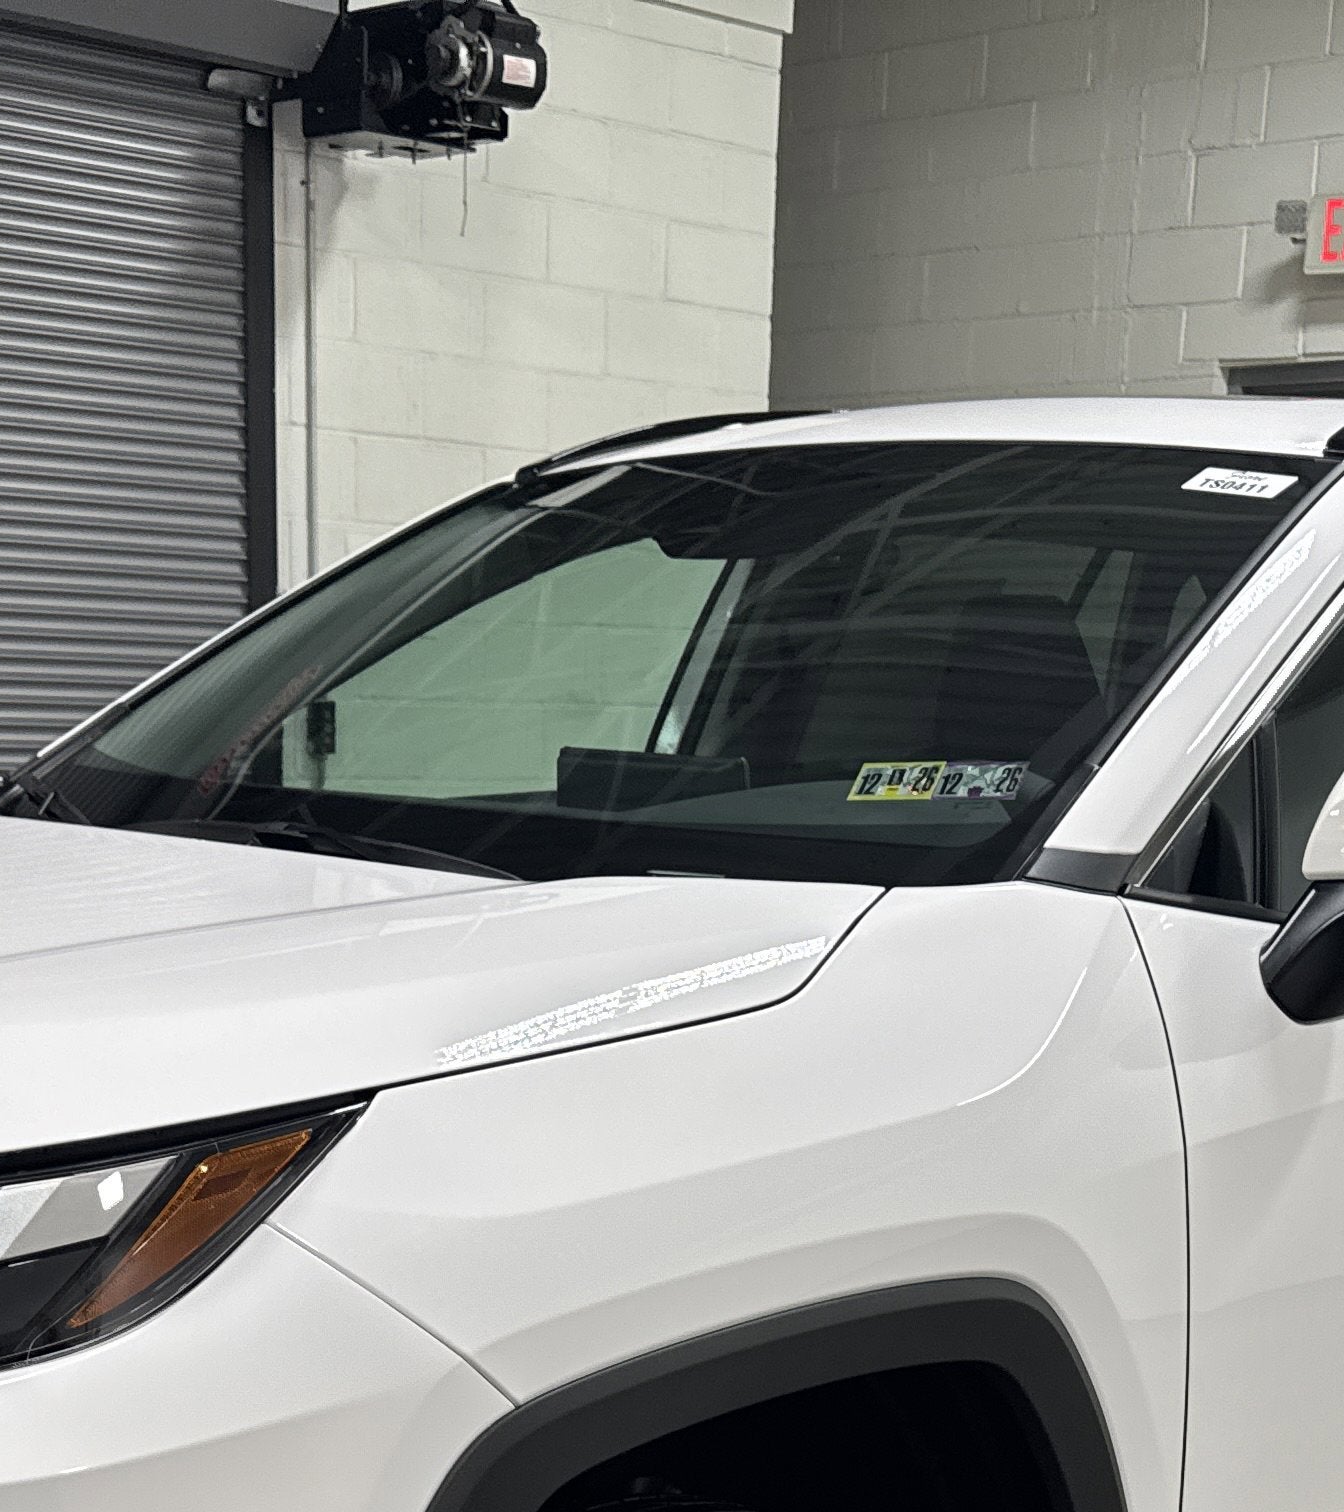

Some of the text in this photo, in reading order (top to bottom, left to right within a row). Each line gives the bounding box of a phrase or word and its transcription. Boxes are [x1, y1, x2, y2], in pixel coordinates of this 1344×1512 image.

[1199, 478, 1269, 494] TS0411
[856, 773, 883, 795] 12
[911, 766, 940, 792] 26
[939, 766, 1023, 795] 12 26
